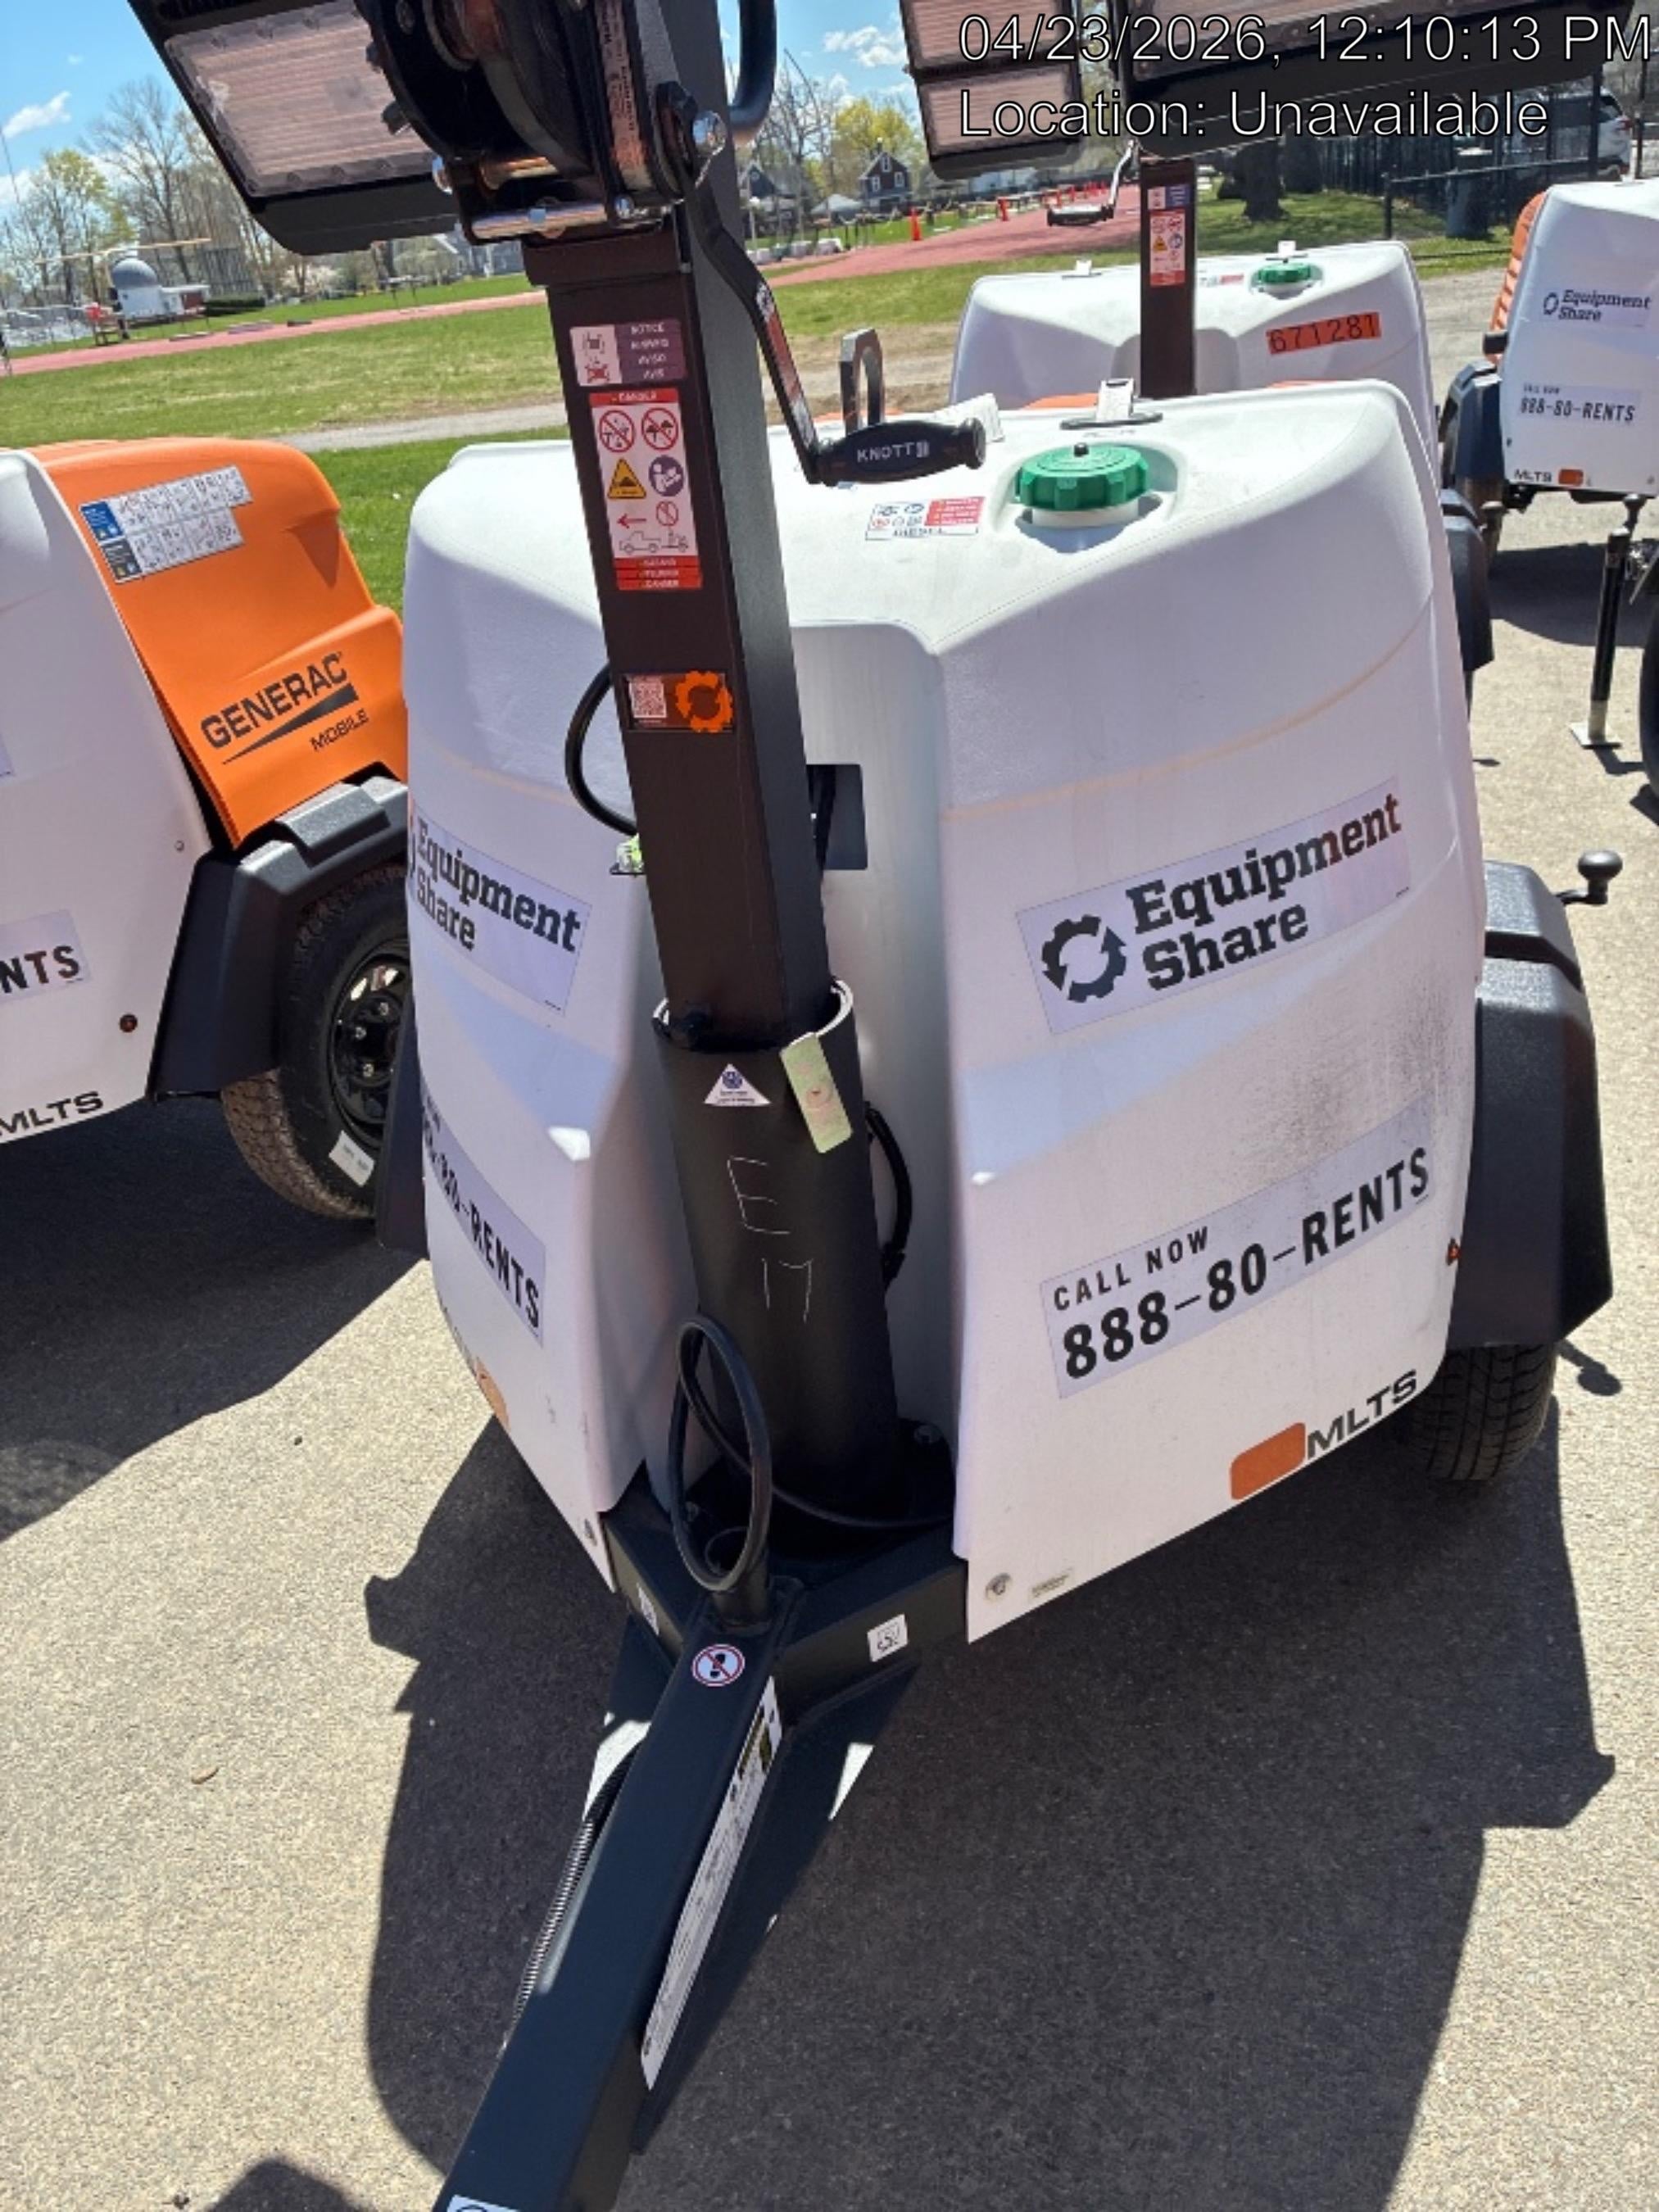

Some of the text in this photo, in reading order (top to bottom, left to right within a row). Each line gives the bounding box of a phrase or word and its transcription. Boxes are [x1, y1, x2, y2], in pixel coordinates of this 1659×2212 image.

[1270, 314, 1376, 352] 671281
[1558, 306, 1602, 321] Share
[1562, 289, 1650, 310] Equipment
[857, 442, 915, 463] KNOTT
[201, 652, 347, 749] GENERAC
[310, 708, 369, 751] MOBILE
[417, 817, 580, 952] Equipment
[1126, 793, 1402, 935] Equipment
[417, 867, 475, 950] Share
[1143, 904, 1309, 990] Share
[1054, 1226, 1208, 1312] CALL NOW
[1063, 1147, 1430, 1380] 888-80-RENTS
[1308, 1369, 1417, 1461] MLTS
